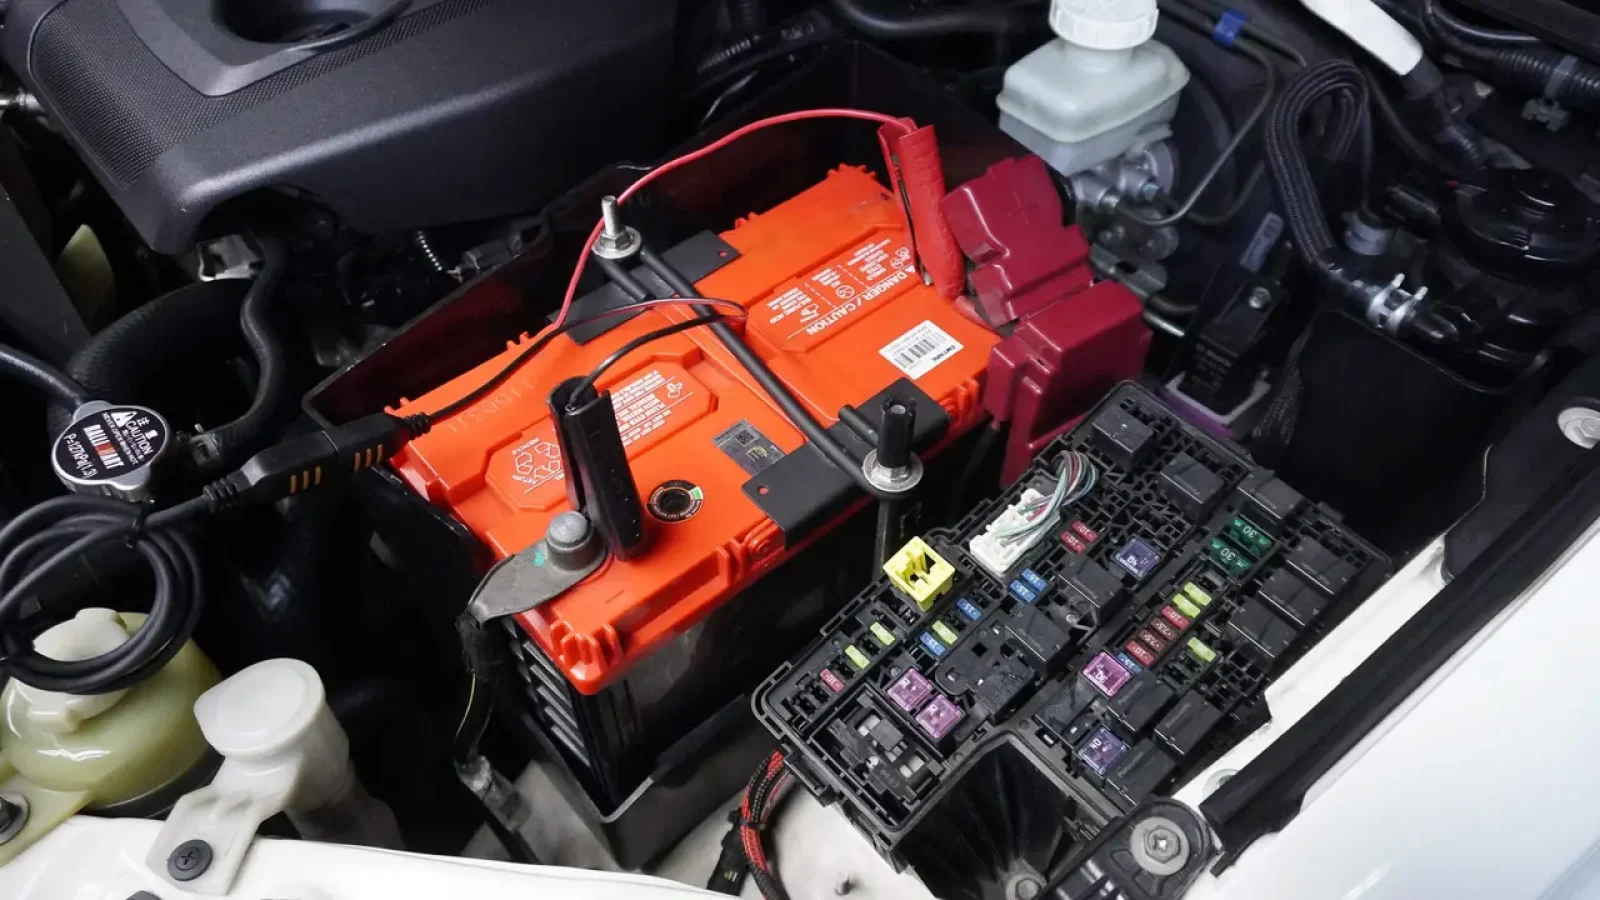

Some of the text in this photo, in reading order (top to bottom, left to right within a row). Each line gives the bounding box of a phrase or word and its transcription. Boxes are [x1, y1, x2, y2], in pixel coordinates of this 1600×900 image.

[863, 271, 908, 301] DANGER
[806, 302, 856, 335] CAUTION
[125, 420, 154, 455] CAUTION
[1243, 525, 1258, 538] 30
[1220, 548, 1236, 561] 30
